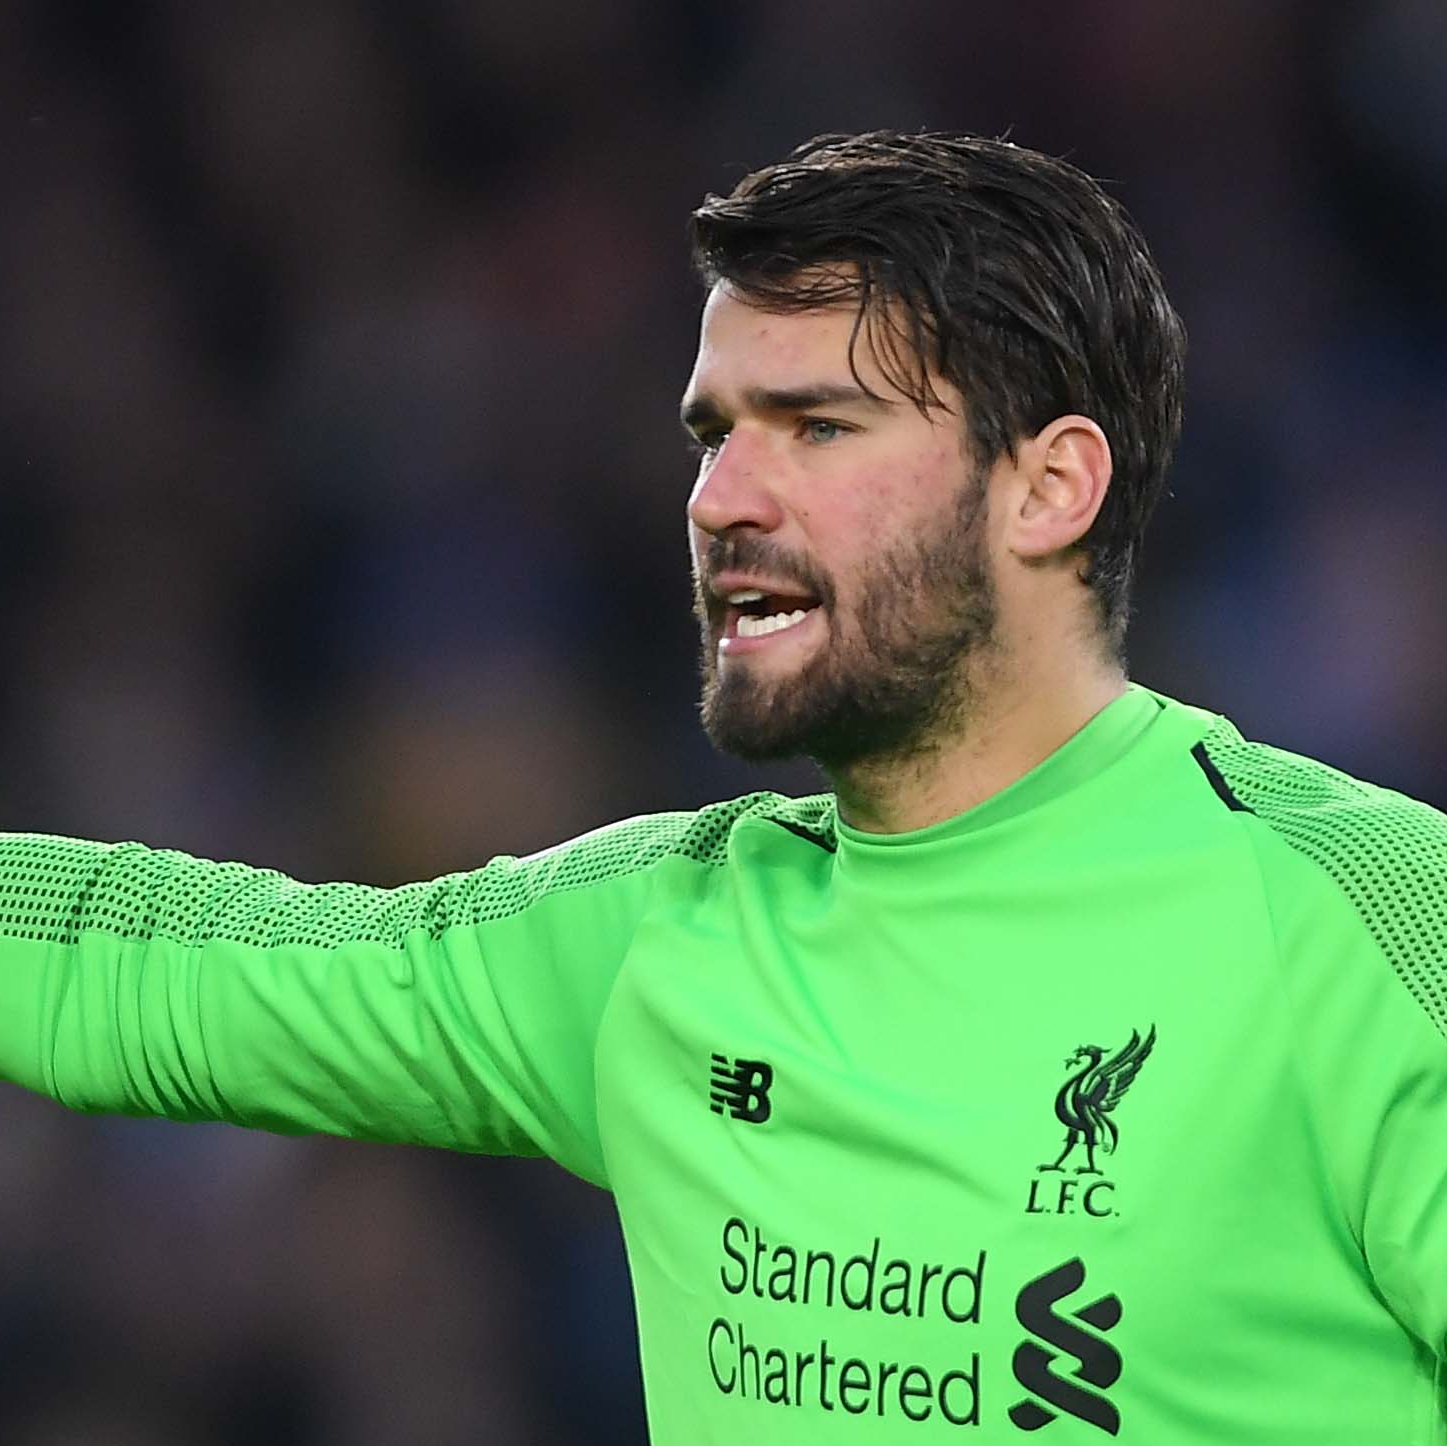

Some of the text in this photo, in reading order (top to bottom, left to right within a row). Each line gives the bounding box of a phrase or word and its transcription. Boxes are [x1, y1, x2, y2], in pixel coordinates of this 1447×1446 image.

[1025, 1179, 1120, 1217] L.F.C.
[721, 1218, 986, 1324] Standard
[708, 1319, 979, 1426] Chartered
